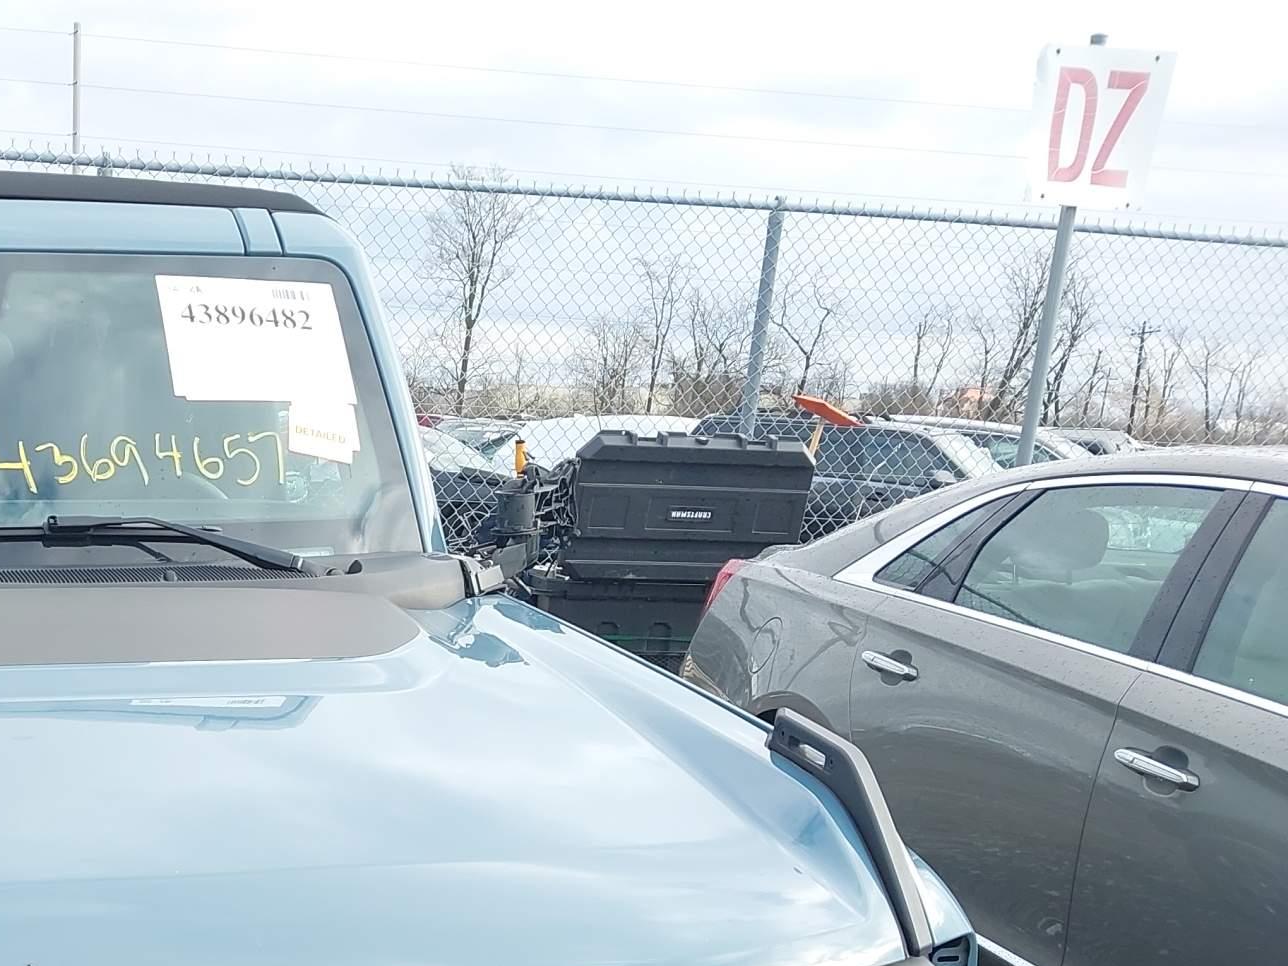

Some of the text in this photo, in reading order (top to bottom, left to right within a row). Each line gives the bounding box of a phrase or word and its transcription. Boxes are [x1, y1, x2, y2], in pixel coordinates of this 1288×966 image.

[1047, 66, 1151, 188] DZ
[181, 303, 313, 330] 43896482
[295, 425, 346, 444] DETAILED
[671, 510, 712, 519] CRAFTSMAN
